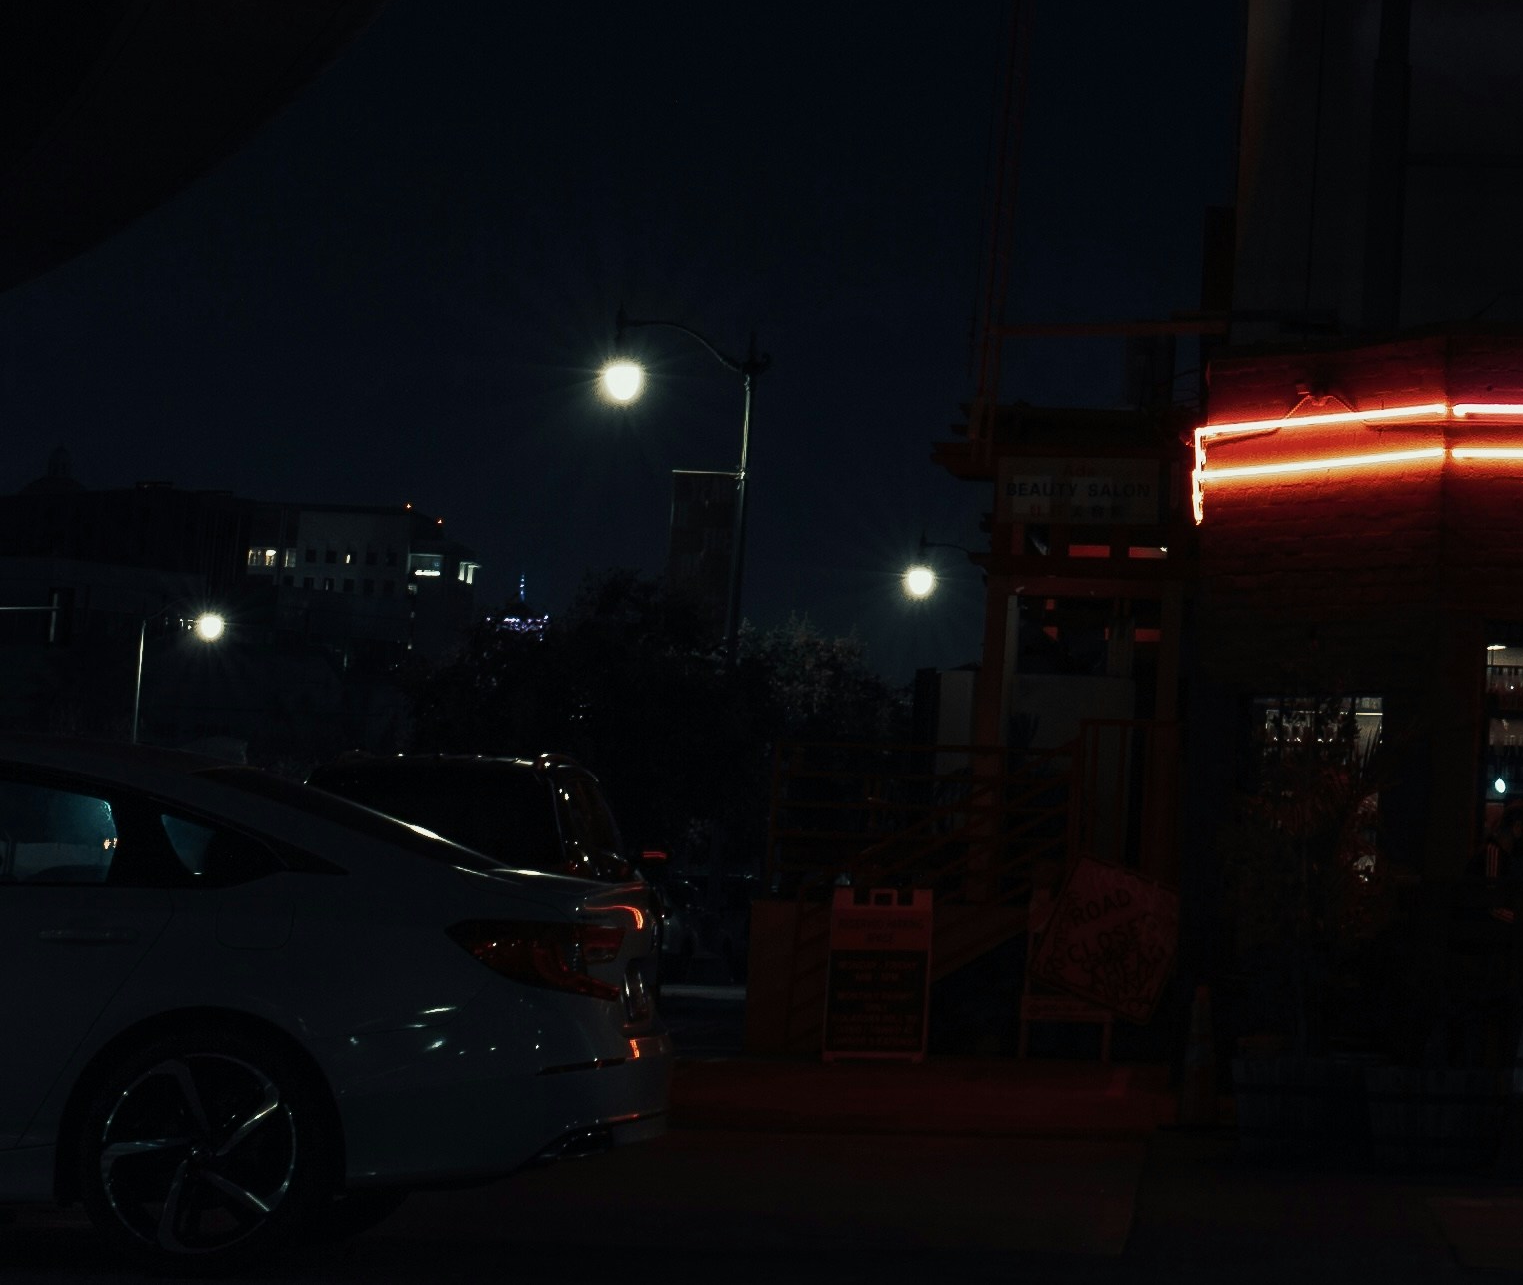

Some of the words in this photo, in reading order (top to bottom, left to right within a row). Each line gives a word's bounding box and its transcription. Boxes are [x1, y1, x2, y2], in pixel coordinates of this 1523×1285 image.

[1006, 482, 1077, 496] BEAUTY
[1088, 483, 1151, 497] SALON
[1069, 889, 1130, 927] ROAD
